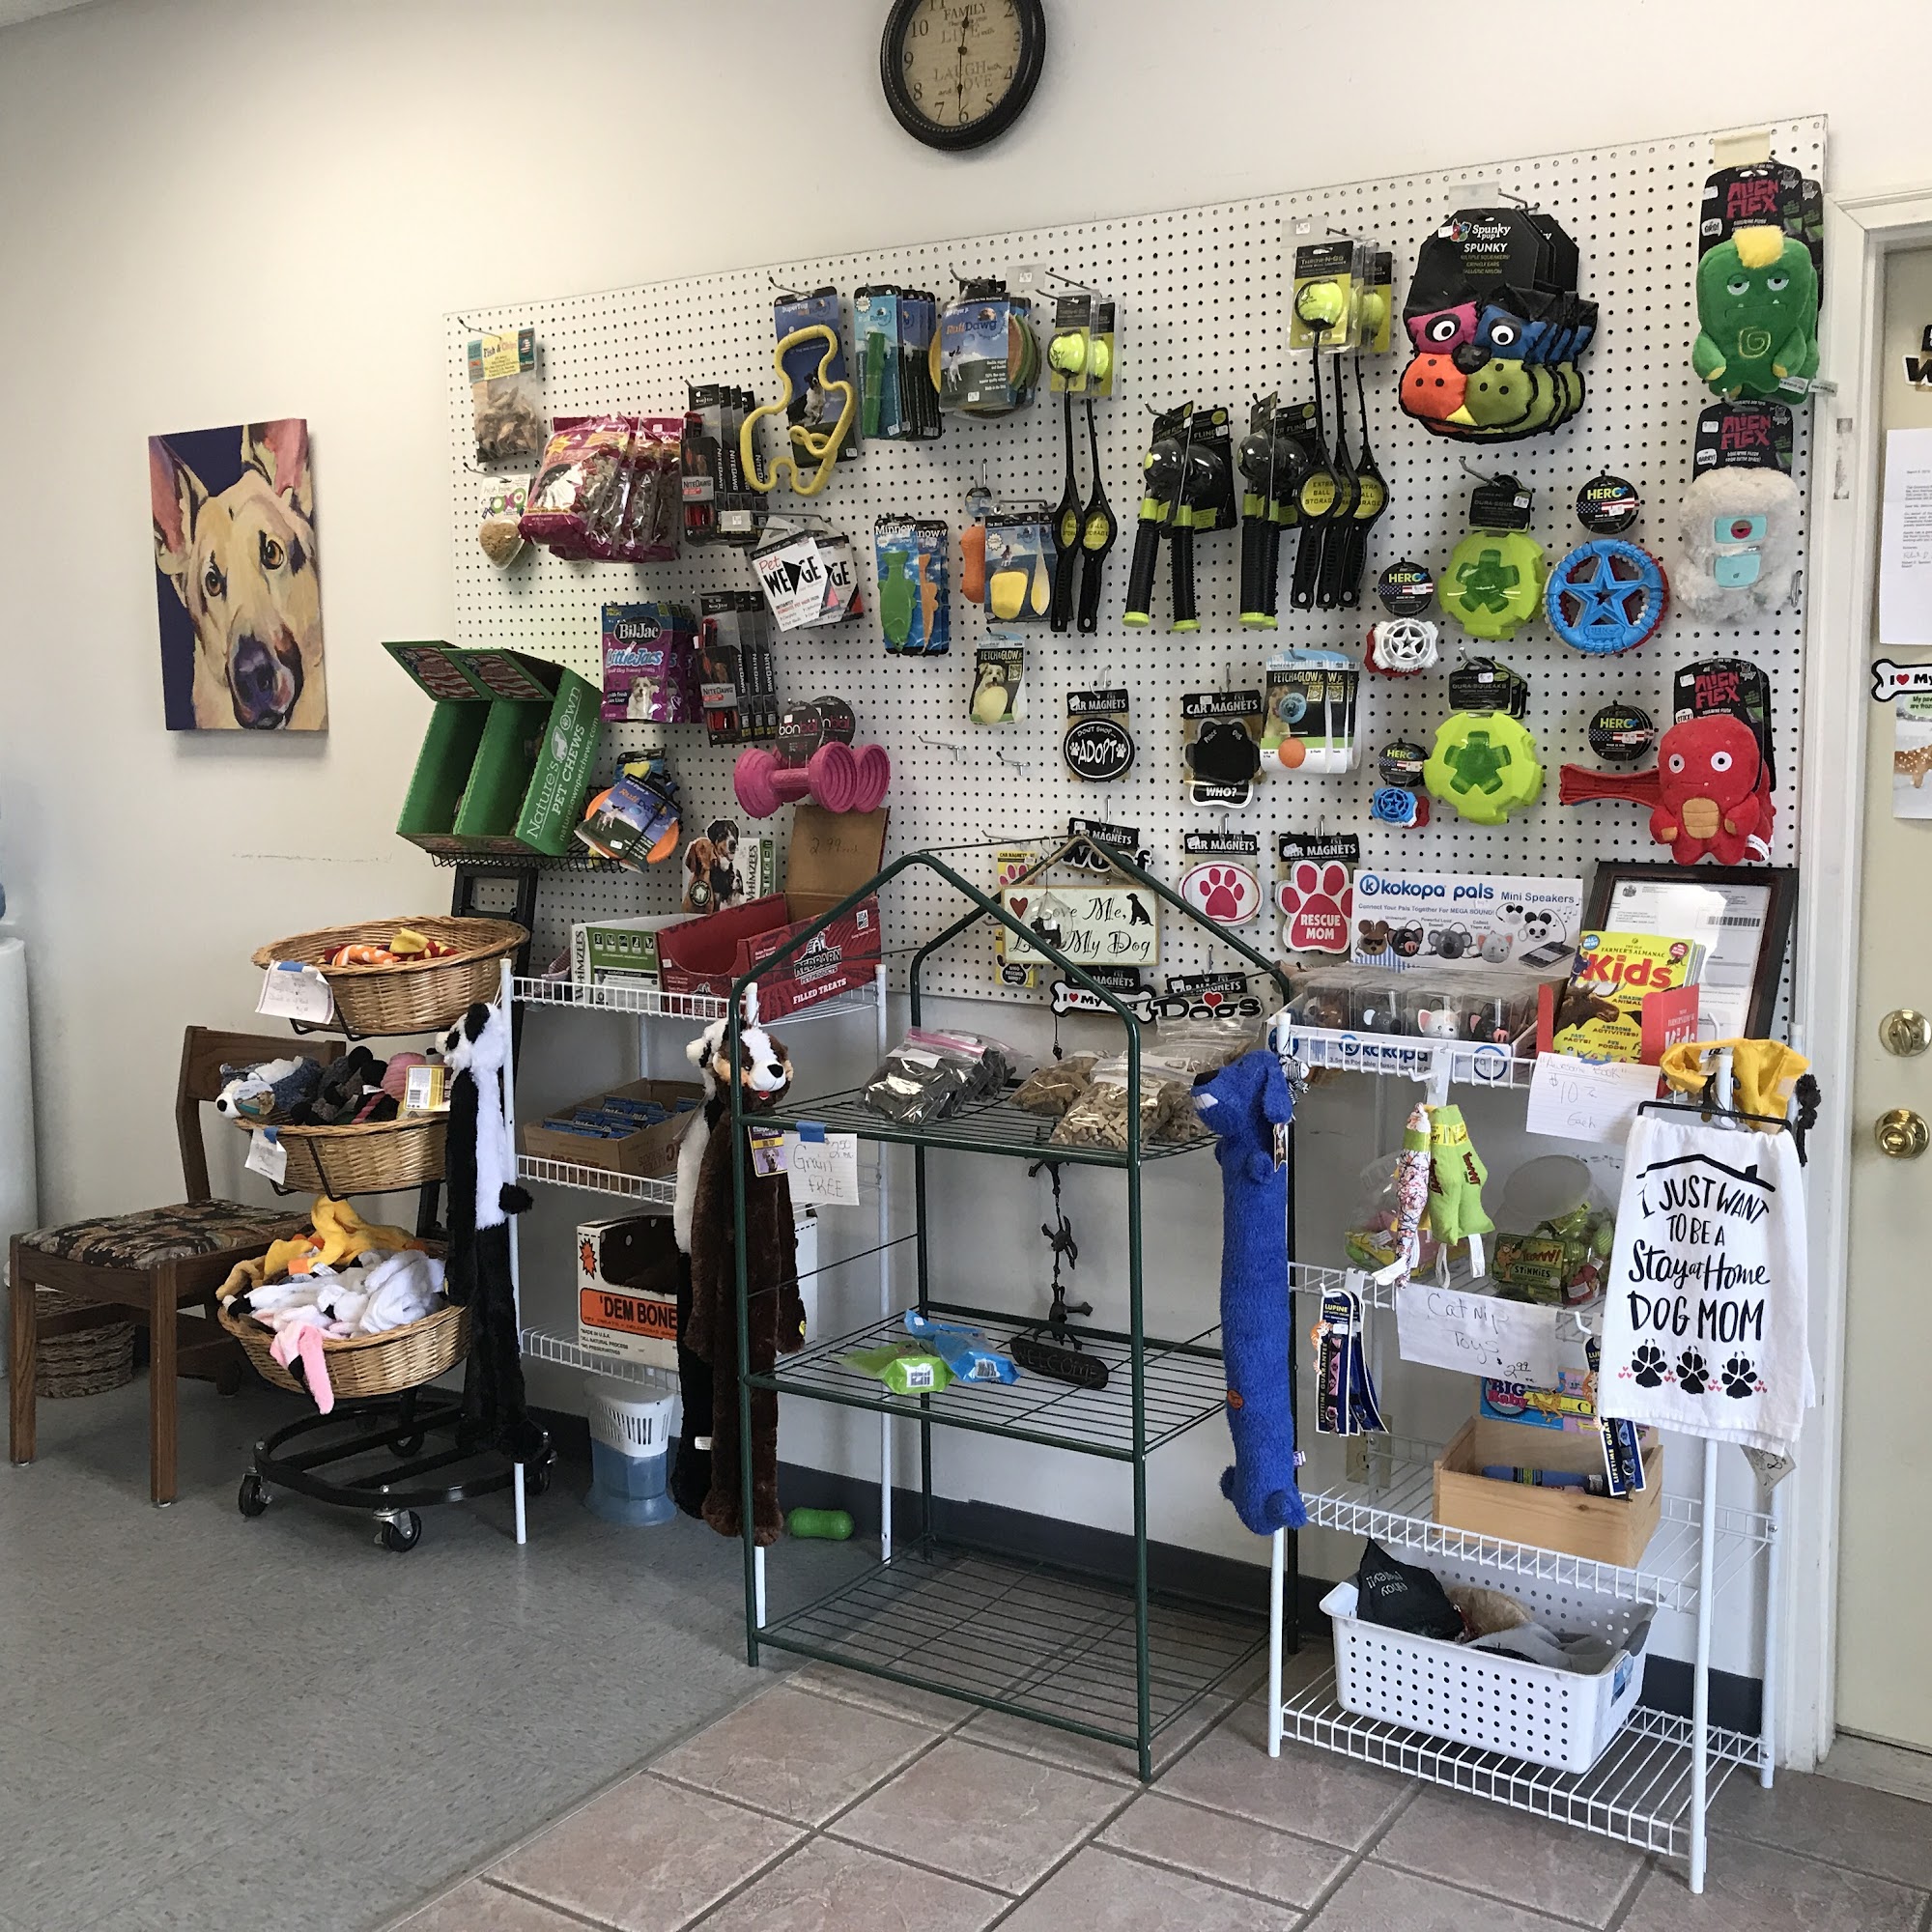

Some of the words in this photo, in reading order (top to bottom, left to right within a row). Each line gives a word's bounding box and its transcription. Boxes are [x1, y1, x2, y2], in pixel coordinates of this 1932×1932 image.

[944, 3, 986, 20] FAMILY
[911, 19, 928, 38] 10
[903, 51, 914, 71] 9
[934, 61, 986, 82] LAUGH
[1004, 66, 1012, 79] 4
[913, 82, 923, 100] 8
[934, 101, 944, 121] 7
[958, 103, 969, 124] 6
[1727, 180, 1779, 202] ALIEN
[1726, 194, 1778, 219] FLEX
[1472, 223, 1511, 238] Spunky
[1463, 242, 1508, 253] SPUNKY
[965, 320, 998, 331] Dawg
[484, 347, 496, 357] Fish
[1721, 414, 1771, 434] ALIEN
[1720, 430, 1771, 450] FLEX
[729, 450, 738, 492] NITEDAWG
[1587, 487, 1622, 500] HERO
[874, 523, 917, 535] Minnow
[758, 555, 781, 573] Pet
[1388, 573, 1422, 583] HERO
[980, 650, 999, 661] FETCH
[1001, 650, 1019, 660] GLOW
[737, 654, 747, 695] NITEDAWG
[763, 653, 774, 693] NITEDAWG
[1273, 671, 1294, 683] FETCH
[1297, 671, 1319, 683] GLOW
[1695, 670, 1740, 693] ALIEN
[1889, 674, 1895, 686] I
[702, 686, 734, 696] NITEDAWG
[1695, 686, 1741, 709] FLEX
[1089, 698, 1126, 710] MAGNETS
[1186, 703, 1208, 714] CAR
[1210, 699, 1258, 713] MAGNETS
[1600, 718, 1633, 728] HERO
[1077, 738, 1118, 765] ADOPT
[1386, 750, 1414, 759] HERO
[552, 785, 568, 815] PET
[561, 724, 585, 782] CHEWS
[558, 718, 600, 840] naturesownpetchews.com
[527, 740, 560, 840] Nature's
[1206, 787, 1237, 797] WHO?
[1093, 831, 1131, 845] MAGNETS
[1210, 839, 1255, 851] MAGNETS
[1307, 844, 1356, 856] MAGNETS
[1381, 879, 1446, 899] kokopa
[1453, 883, 1494, 901] pals
[1501, 892, 1522, 901] Mini
[1524, 893, 1575, 903] Speakers
[1082, 896, 1126, 923] Me,
[1300, 914, 1341, 927] RESCUE
[1306, 928, 1334, 940] MOM
[1107, 930, 1151, 962] Dog
[1633, 950, 1665, 958] ALMANAC
[794, 948, 842, 977] REDBARN
[1584, 953, 1672, 988] Kids
[1094, 976, 1134, 987] MAGNETS
[792, 988, 818, 1005] FILLED
[818, 978, 847, 995] TREATS
[1063, 993, 1067, 1002] I
[1080, 993, 1102, 1007] My
[793, 1144, 833, 1172] Grain
[809, 1175, 843, 1198] FREE
[1636, 1183, 1656, 1219] I
[1659, 1175, 1717, 1211] JUST
[1717, 1182, 1770, 1224] WANT
[1666, 1213, 1686, 1242] TO
[1690, 1220, 1711, 1246] BE
[1714, 1225, 1725, 1246] A
[1628, 1238, 1689, 1290] Stay
[1689, 1262, 1704, 1280] at
[1702, 1252, 1771, 1291] Home
[600, 1295, 634, 1321] 'DEM
[1324, 1303, 1349, 1313] LUPINE
[1428, 1293, 1467, 1320] Cat
[1627, 1291, 1690, 1336] DOG
[1697, 1298, 1765, 1343] MOM
[1448, 1328, 1499, 1364] Toys
[1492, 1379, 1525, 1397] BIG
[1488, 1391, 1529, 1409] Baby
